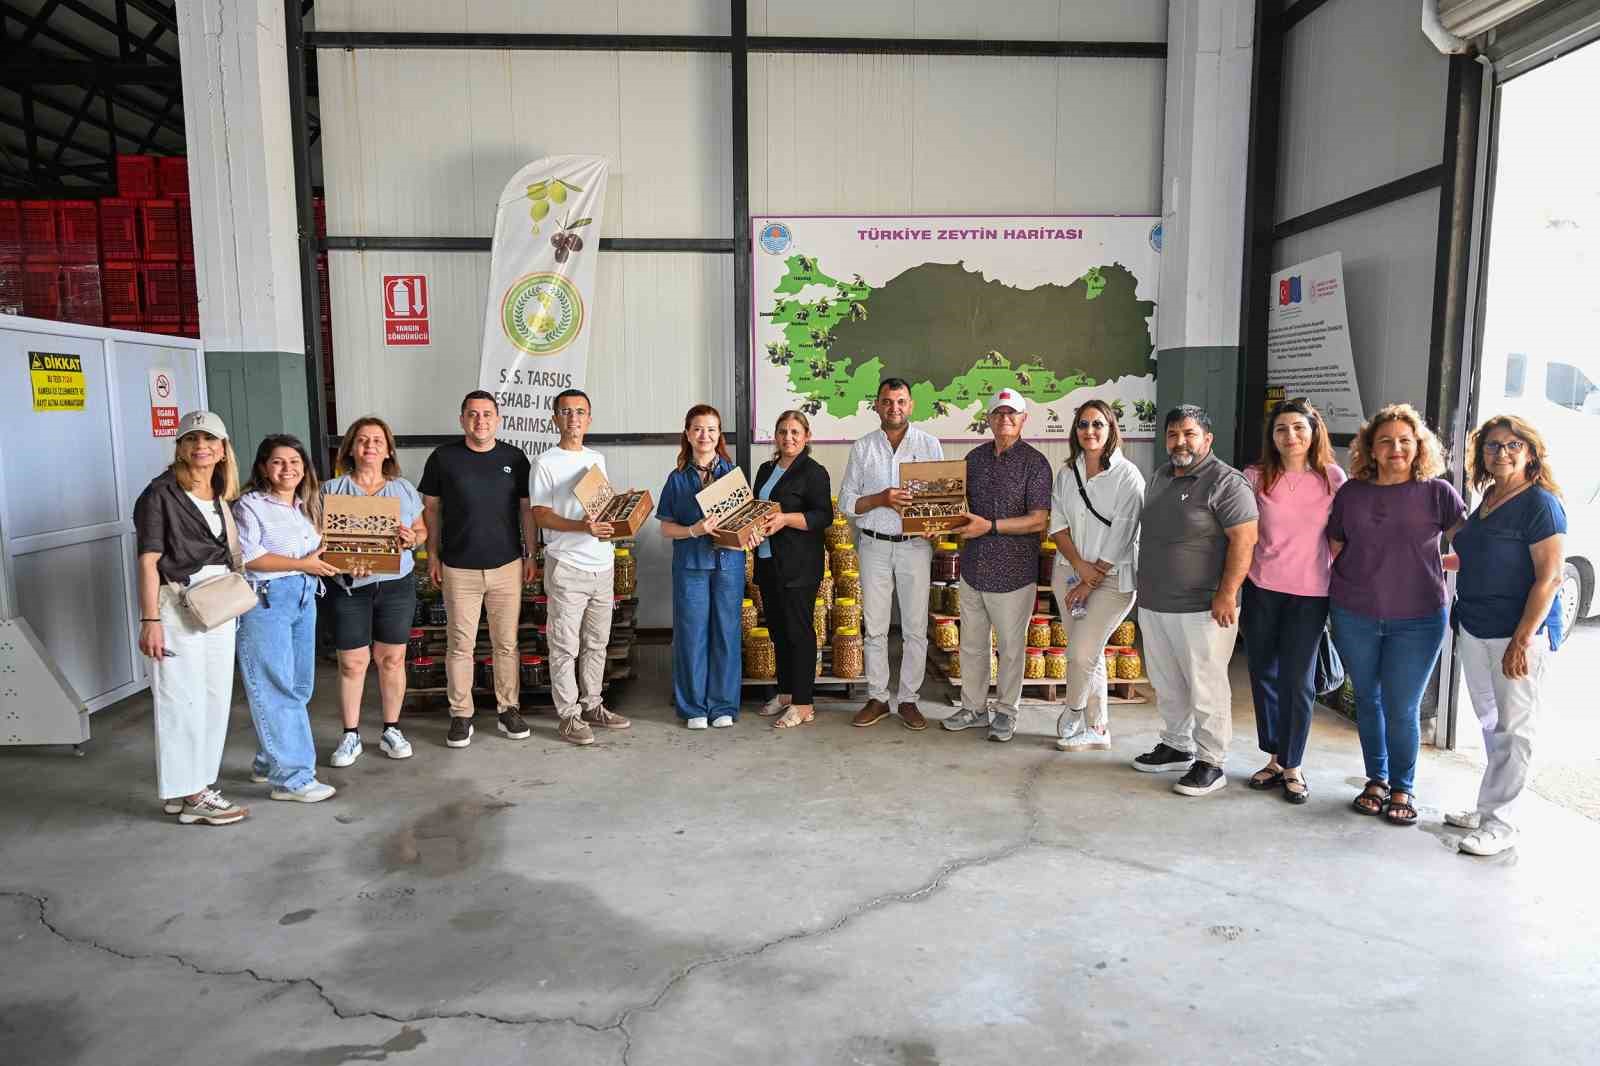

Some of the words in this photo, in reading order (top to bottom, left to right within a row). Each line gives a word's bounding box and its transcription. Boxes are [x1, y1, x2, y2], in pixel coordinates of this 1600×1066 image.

[857, 228, 932, 241] TÜRKİYE
[937, 227, 998, 240] ZEYTİN
[1003, 226, 1083, 240] HARİTASI
[44, 354, 81, 371] DİKKAT
[499, 368, 511, 384] S.
[513, 369, 524, 385] S.
[528, 370, 572, 389] TARSUS
[494, 391, 540, 410] ESHAB-I
